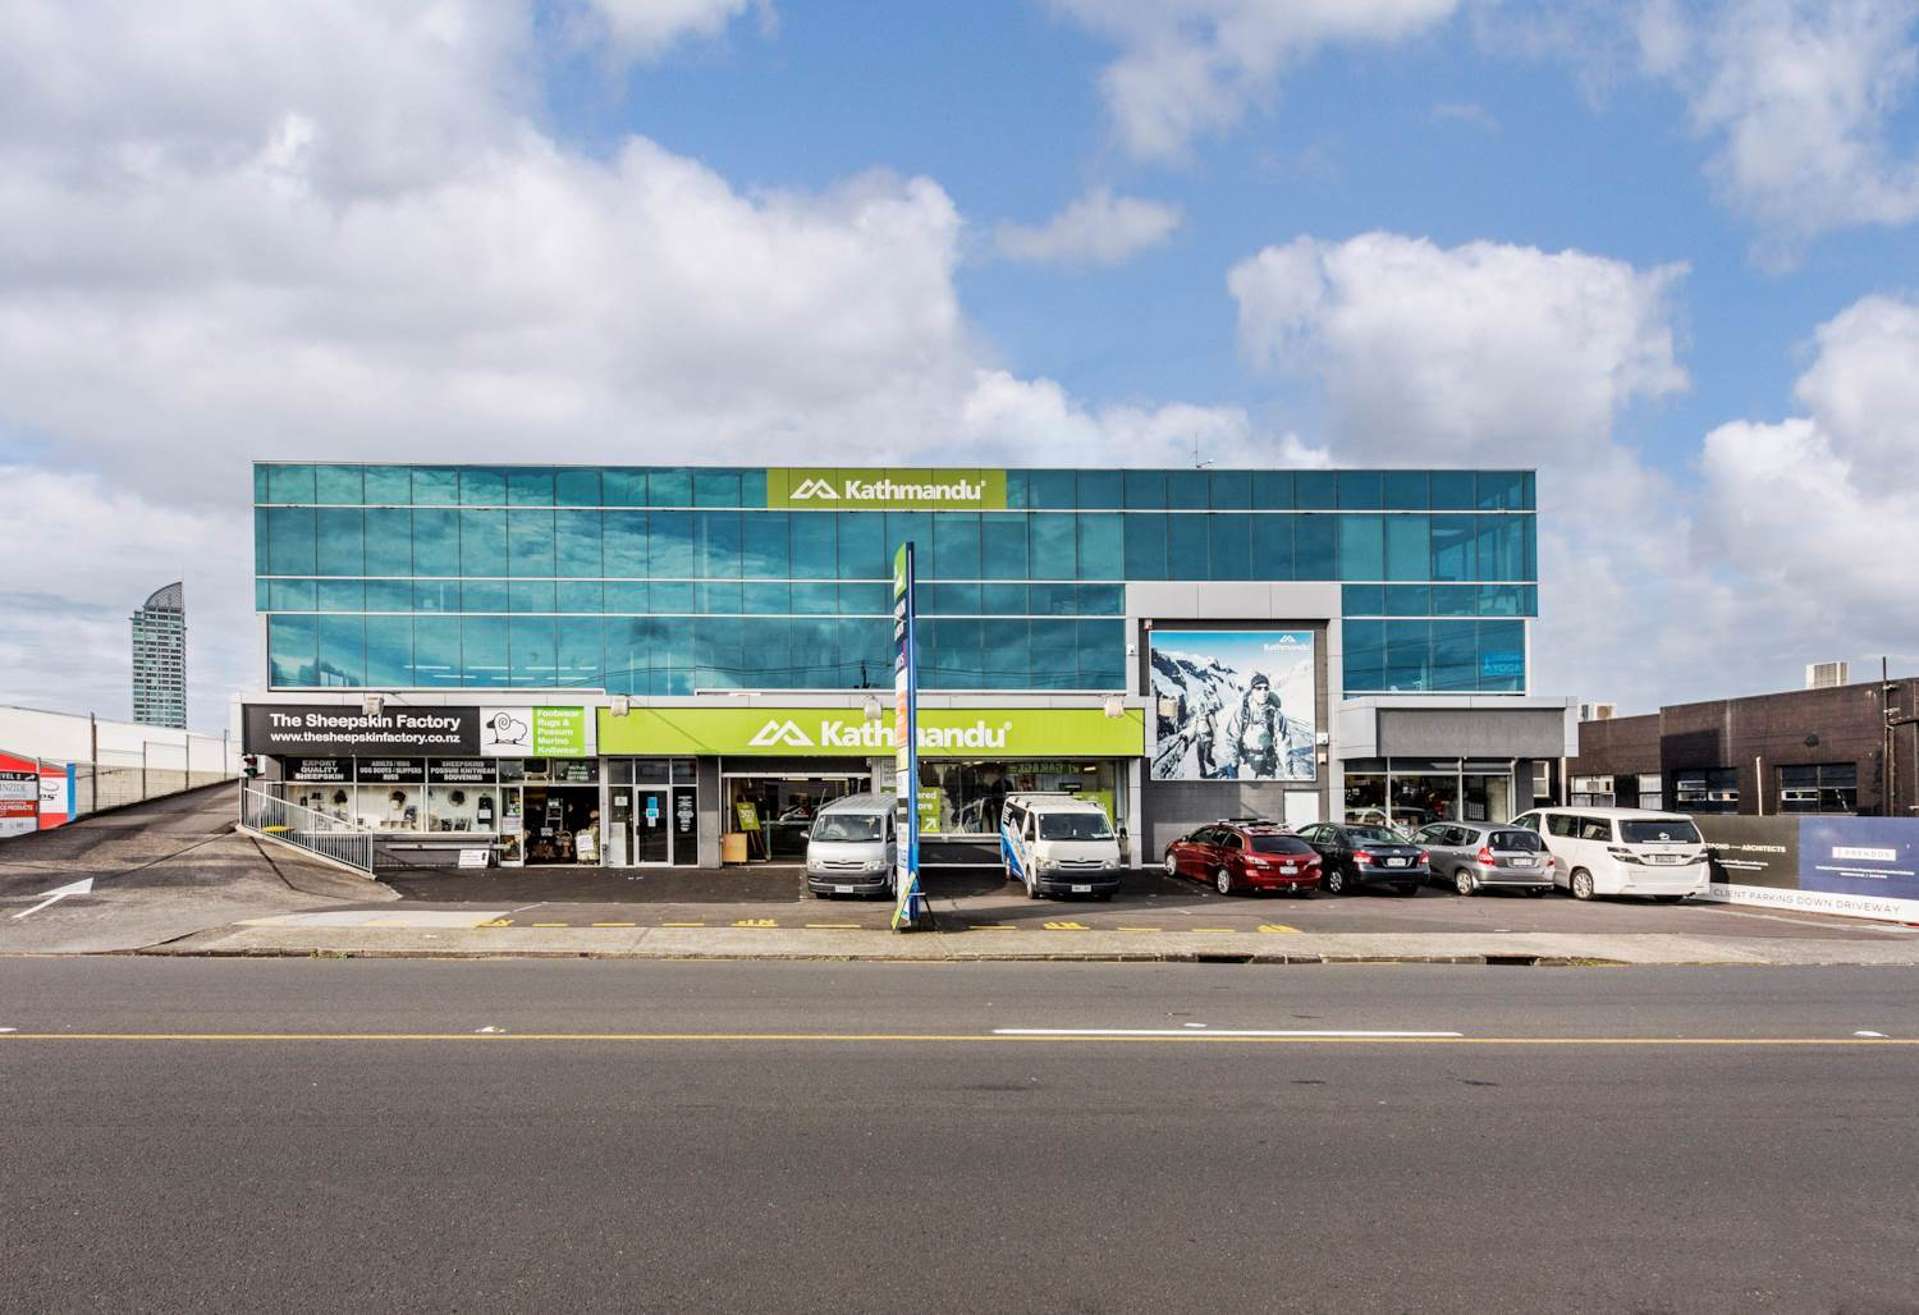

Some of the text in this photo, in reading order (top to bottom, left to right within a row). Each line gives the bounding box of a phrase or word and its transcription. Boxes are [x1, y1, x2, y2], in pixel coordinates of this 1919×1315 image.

[269, 713, 461, 731] The Sheepskin Factory
[270, 732, 461, 744] www.thesheepskinfactory.co.nz
[1713, 888, 1901, 914] CLIENT PARKING DOWN DRIVEWAY
